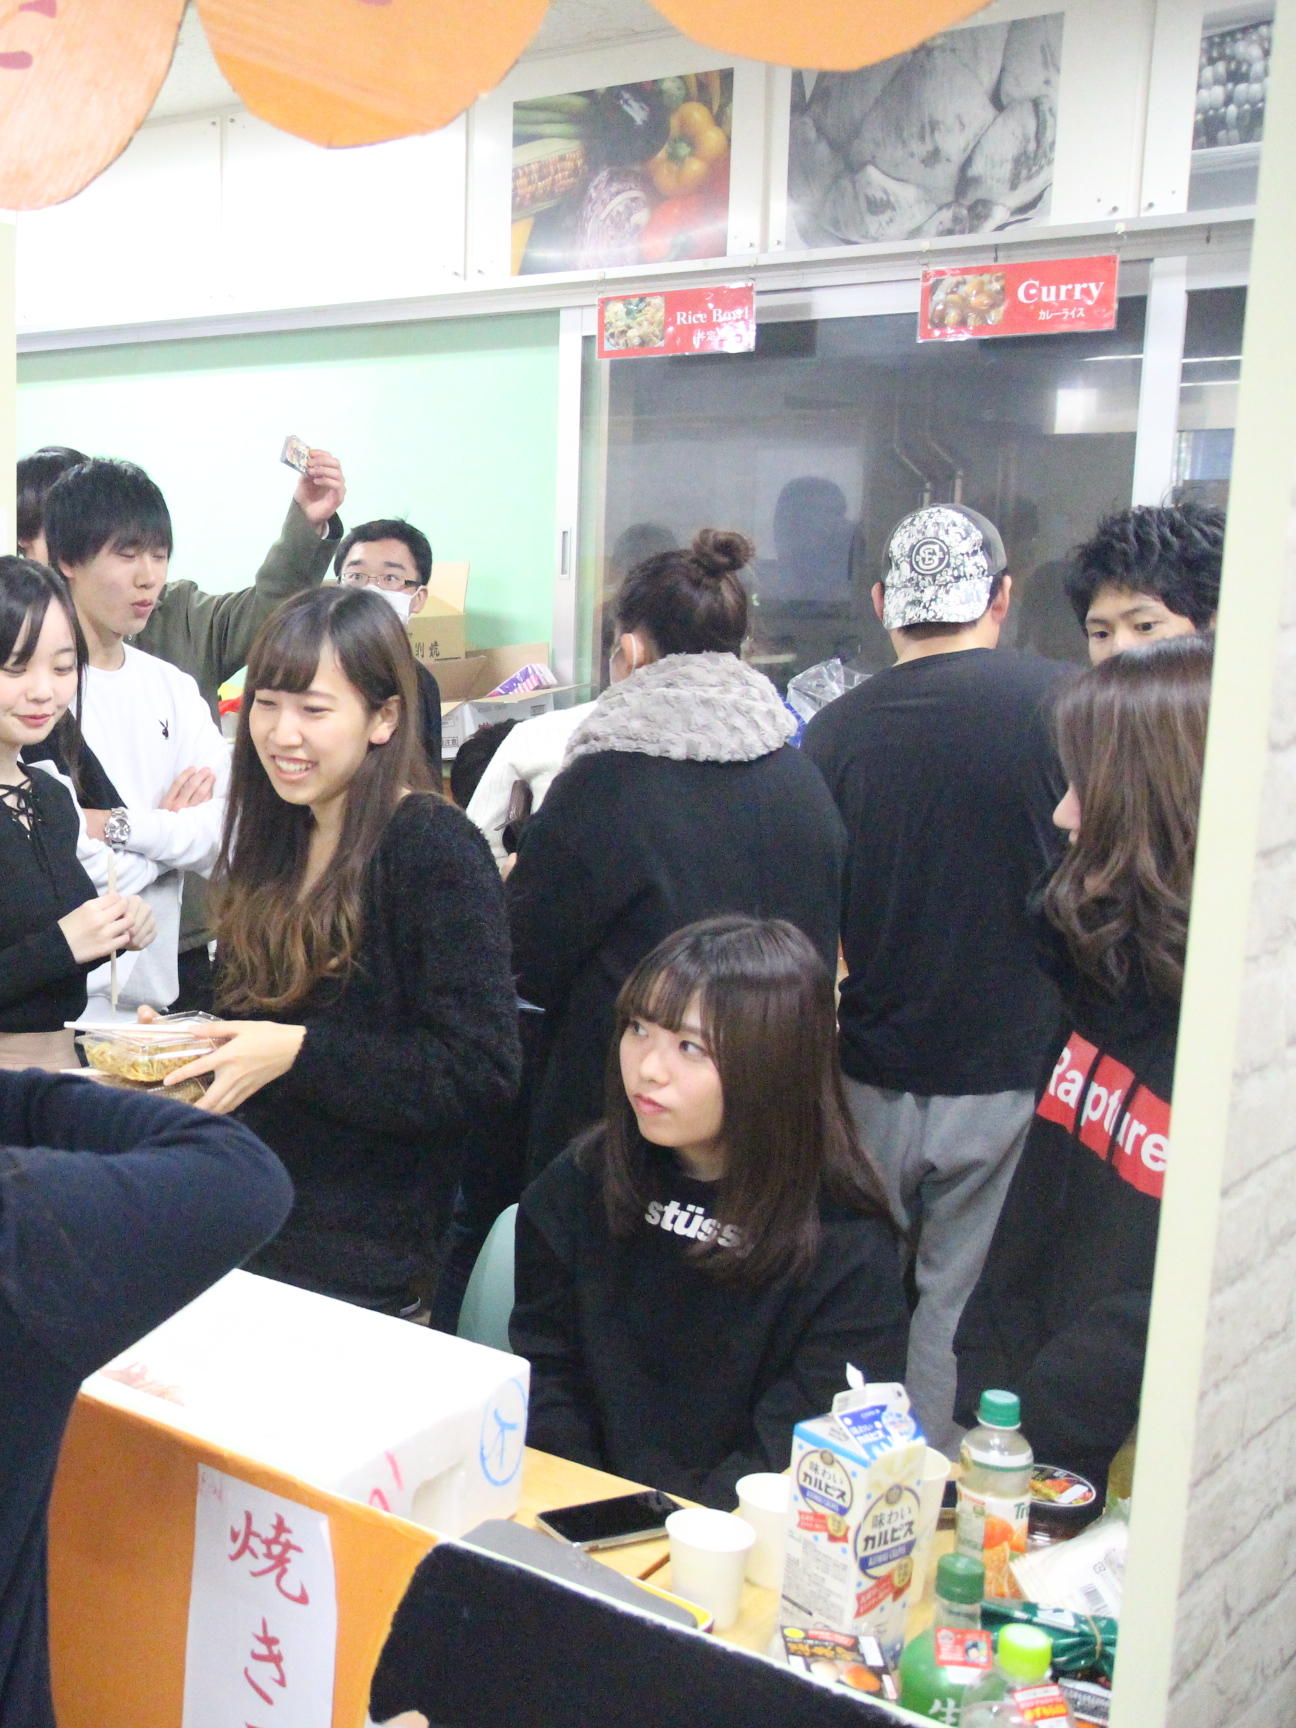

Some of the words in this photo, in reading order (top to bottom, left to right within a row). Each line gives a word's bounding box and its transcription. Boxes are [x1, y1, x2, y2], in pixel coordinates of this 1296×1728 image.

[1017, 279, 1105, 305] Curry
[675, 310, 708, 326] Rice
[1038, 306, 1086, 321] カレーライス
[871, 1506, 912, 1530] 味わい
[863, 1520, 915, 1552] カルピス
[227, 1508, 311, 1728] 焼き
